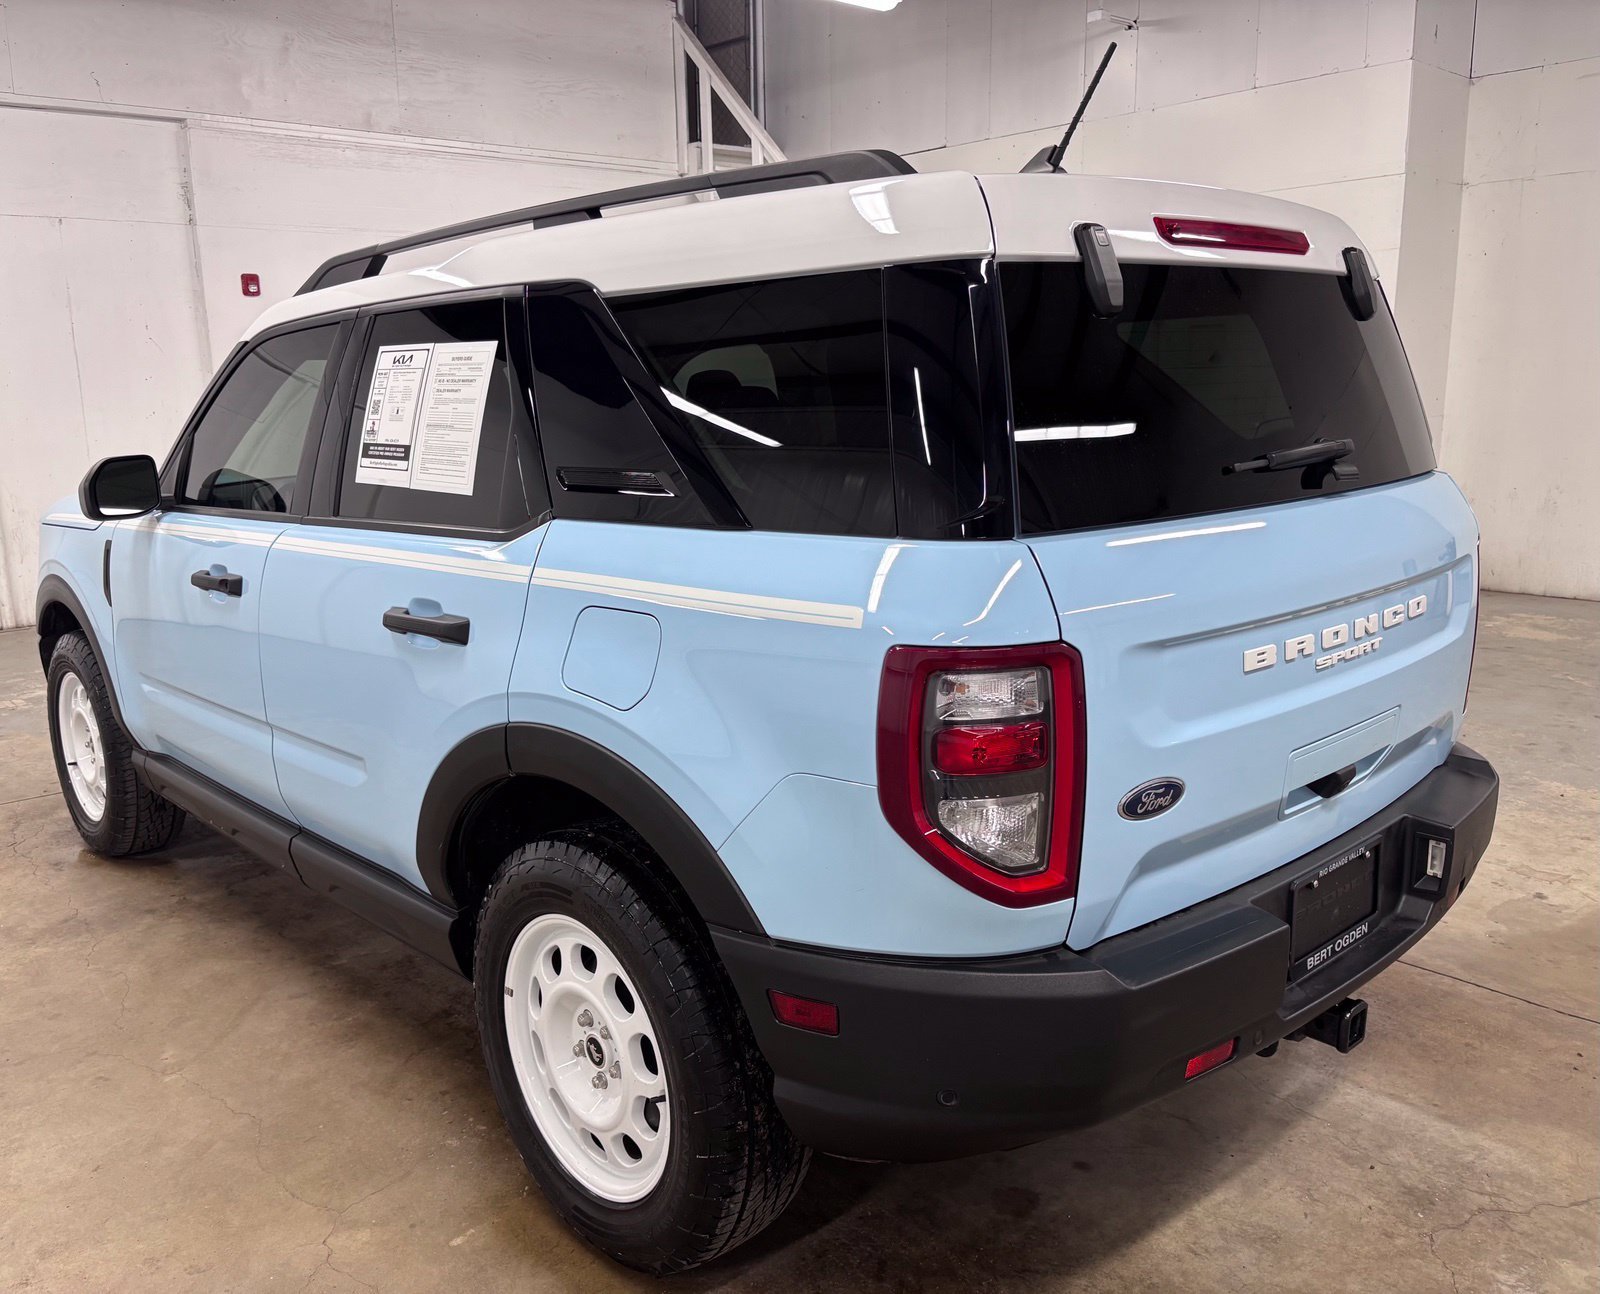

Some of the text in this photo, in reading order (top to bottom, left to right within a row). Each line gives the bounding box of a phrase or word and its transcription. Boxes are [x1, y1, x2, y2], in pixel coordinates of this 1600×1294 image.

[1242, 594, 1427, 674] BRONCO
[1314, 637, 1383, 671] SPORT
[1136, 787, 1175, 813] Ford
[1318, 846, 1366, 878] RIO GRANDE VALLEY
[1306, 922, 1369, 971] BERT OGDEN
